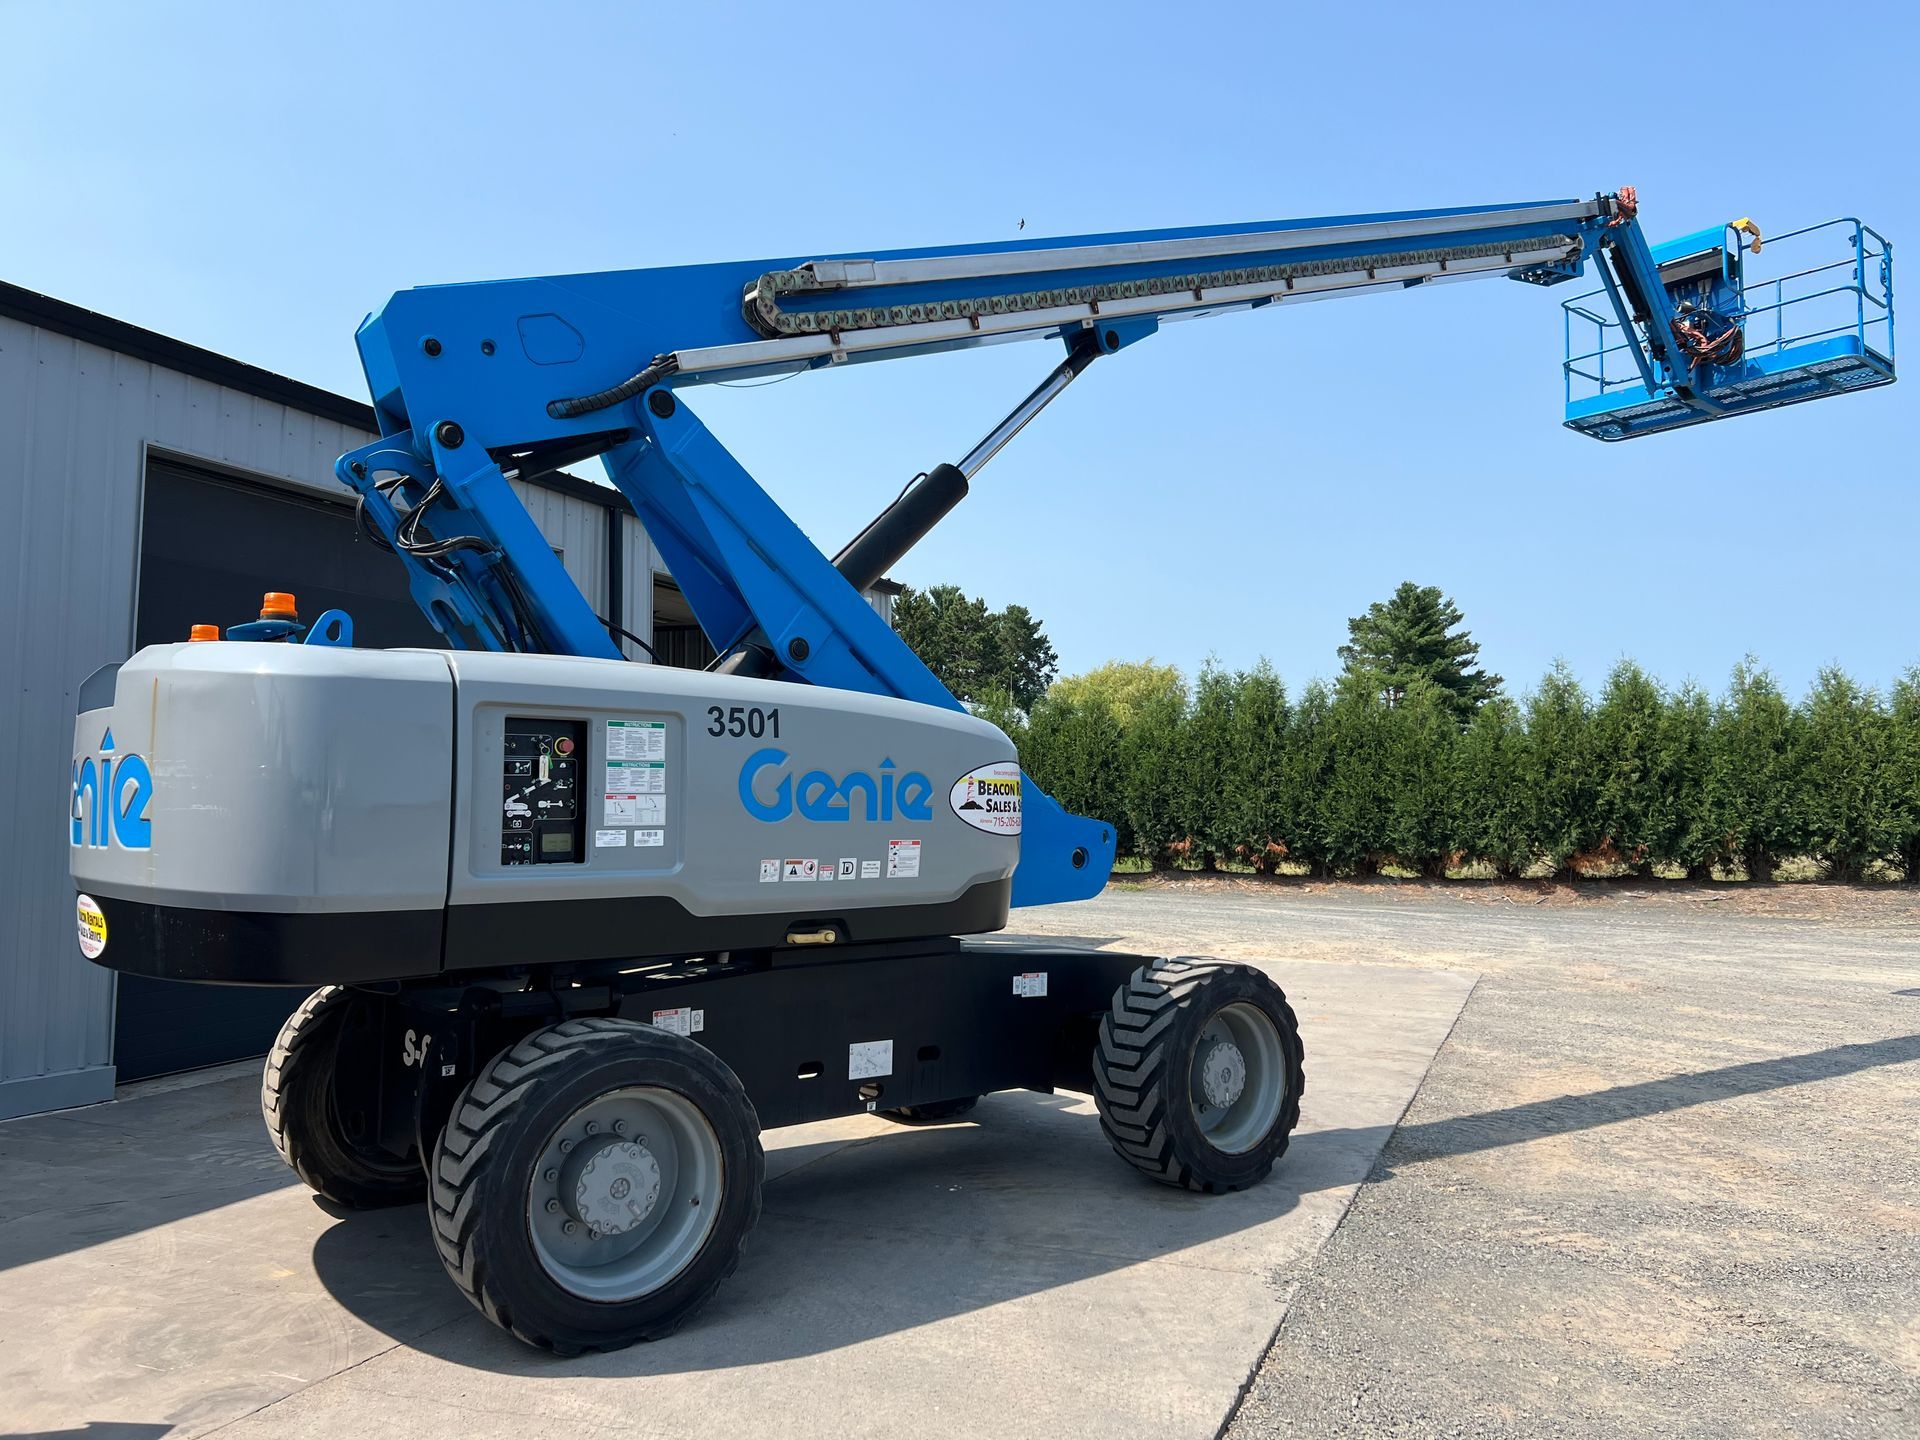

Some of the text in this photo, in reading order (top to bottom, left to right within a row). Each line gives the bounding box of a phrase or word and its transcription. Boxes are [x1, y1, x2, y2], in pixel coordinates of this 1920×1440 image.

[707, 706, 779, 738] 3501
[738, 747, 934, 823] Genie
[978, 780, 1015, 796] BEACON
[986, 798, 1011, 813] SALES
[1012, 800, 1017, 813] &
